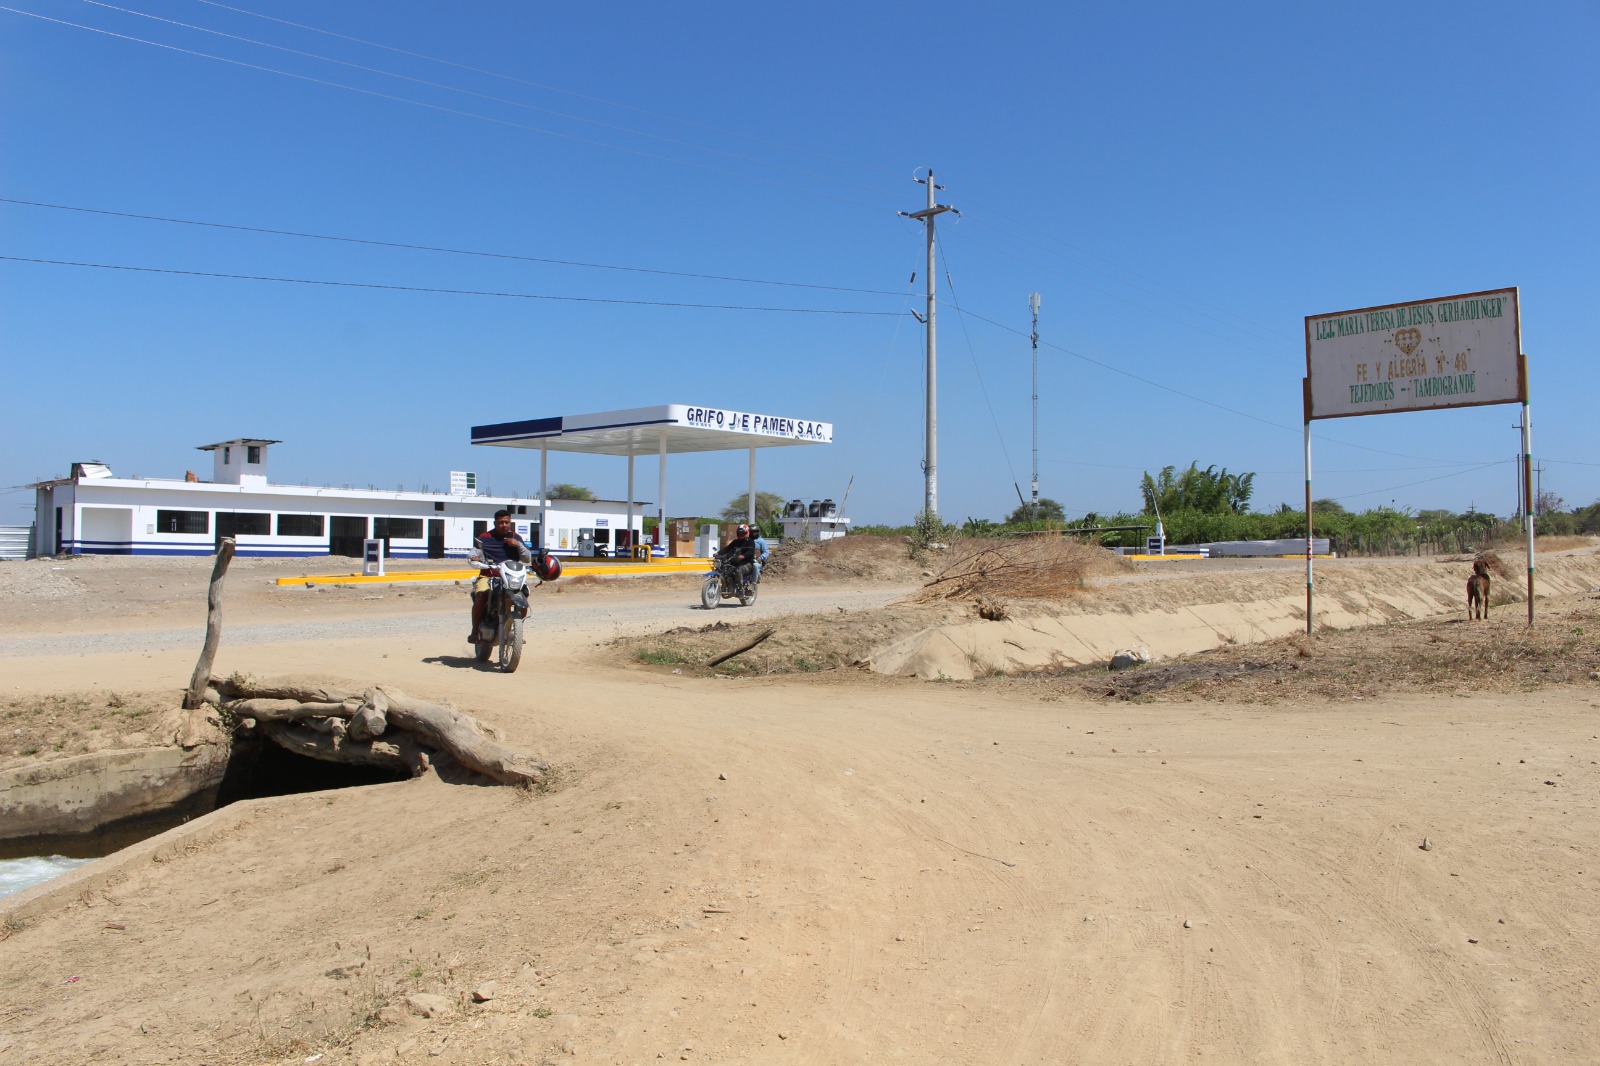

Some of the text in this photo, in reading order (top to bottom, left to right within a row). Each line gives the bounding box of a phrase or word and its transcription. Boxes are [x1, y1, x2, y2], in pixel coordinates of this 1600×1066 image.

[1365, 310, 1395, 333] TERESA
[1396, 307, 1407, 329] DE
[1356, 363, 1368, 382] FE
[1375, 361, 1382, 380] Y
[1454, 352, 1468, 372] 48
[1349, 381, 1395, 404] TEJEDORES
[1414, 373, 1476, 398] TAMBOGRANDE
[687, 407, 724, 425] GRIFO
[753, 415, 795, 433] PAMEN
